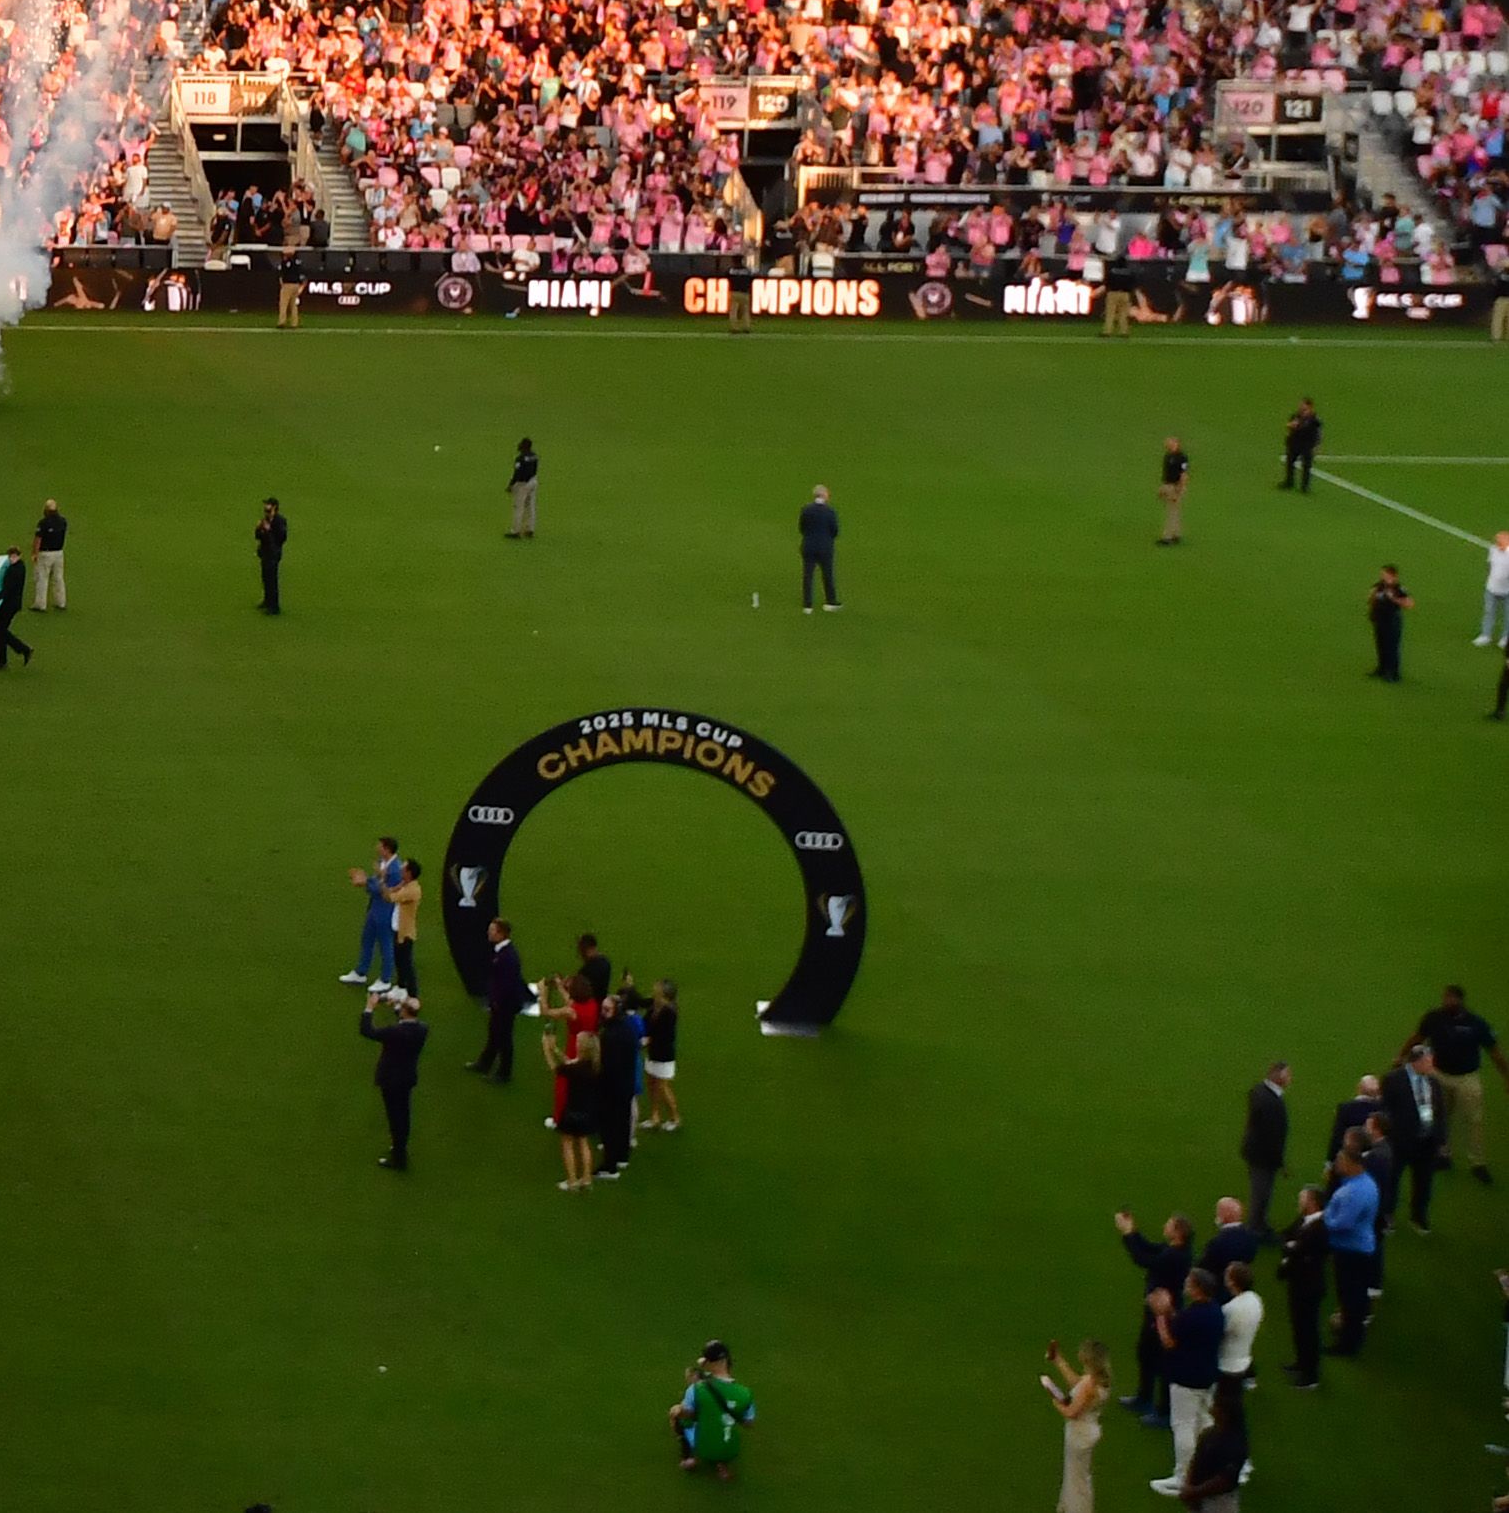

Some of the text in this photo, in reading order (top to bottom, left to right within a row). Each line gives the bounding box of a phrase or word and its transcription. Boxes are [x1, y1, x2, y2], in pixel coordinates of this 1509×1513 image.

[194, 91, 216, 104] 118
[243, 91, 267, 107] 119
[713, 95, 737, 109] 119
[1284, 99, 1313, 118] 121
[308, 281, 391, 295] MLS CUP
[528, 279, 612, 308] MIAMI
[684, 277, 880, 316] CHMPIONS
[579, 711, 744, 748] 2025 MLS CUP
[536, 728, 776, 798] CHAMPIONS
